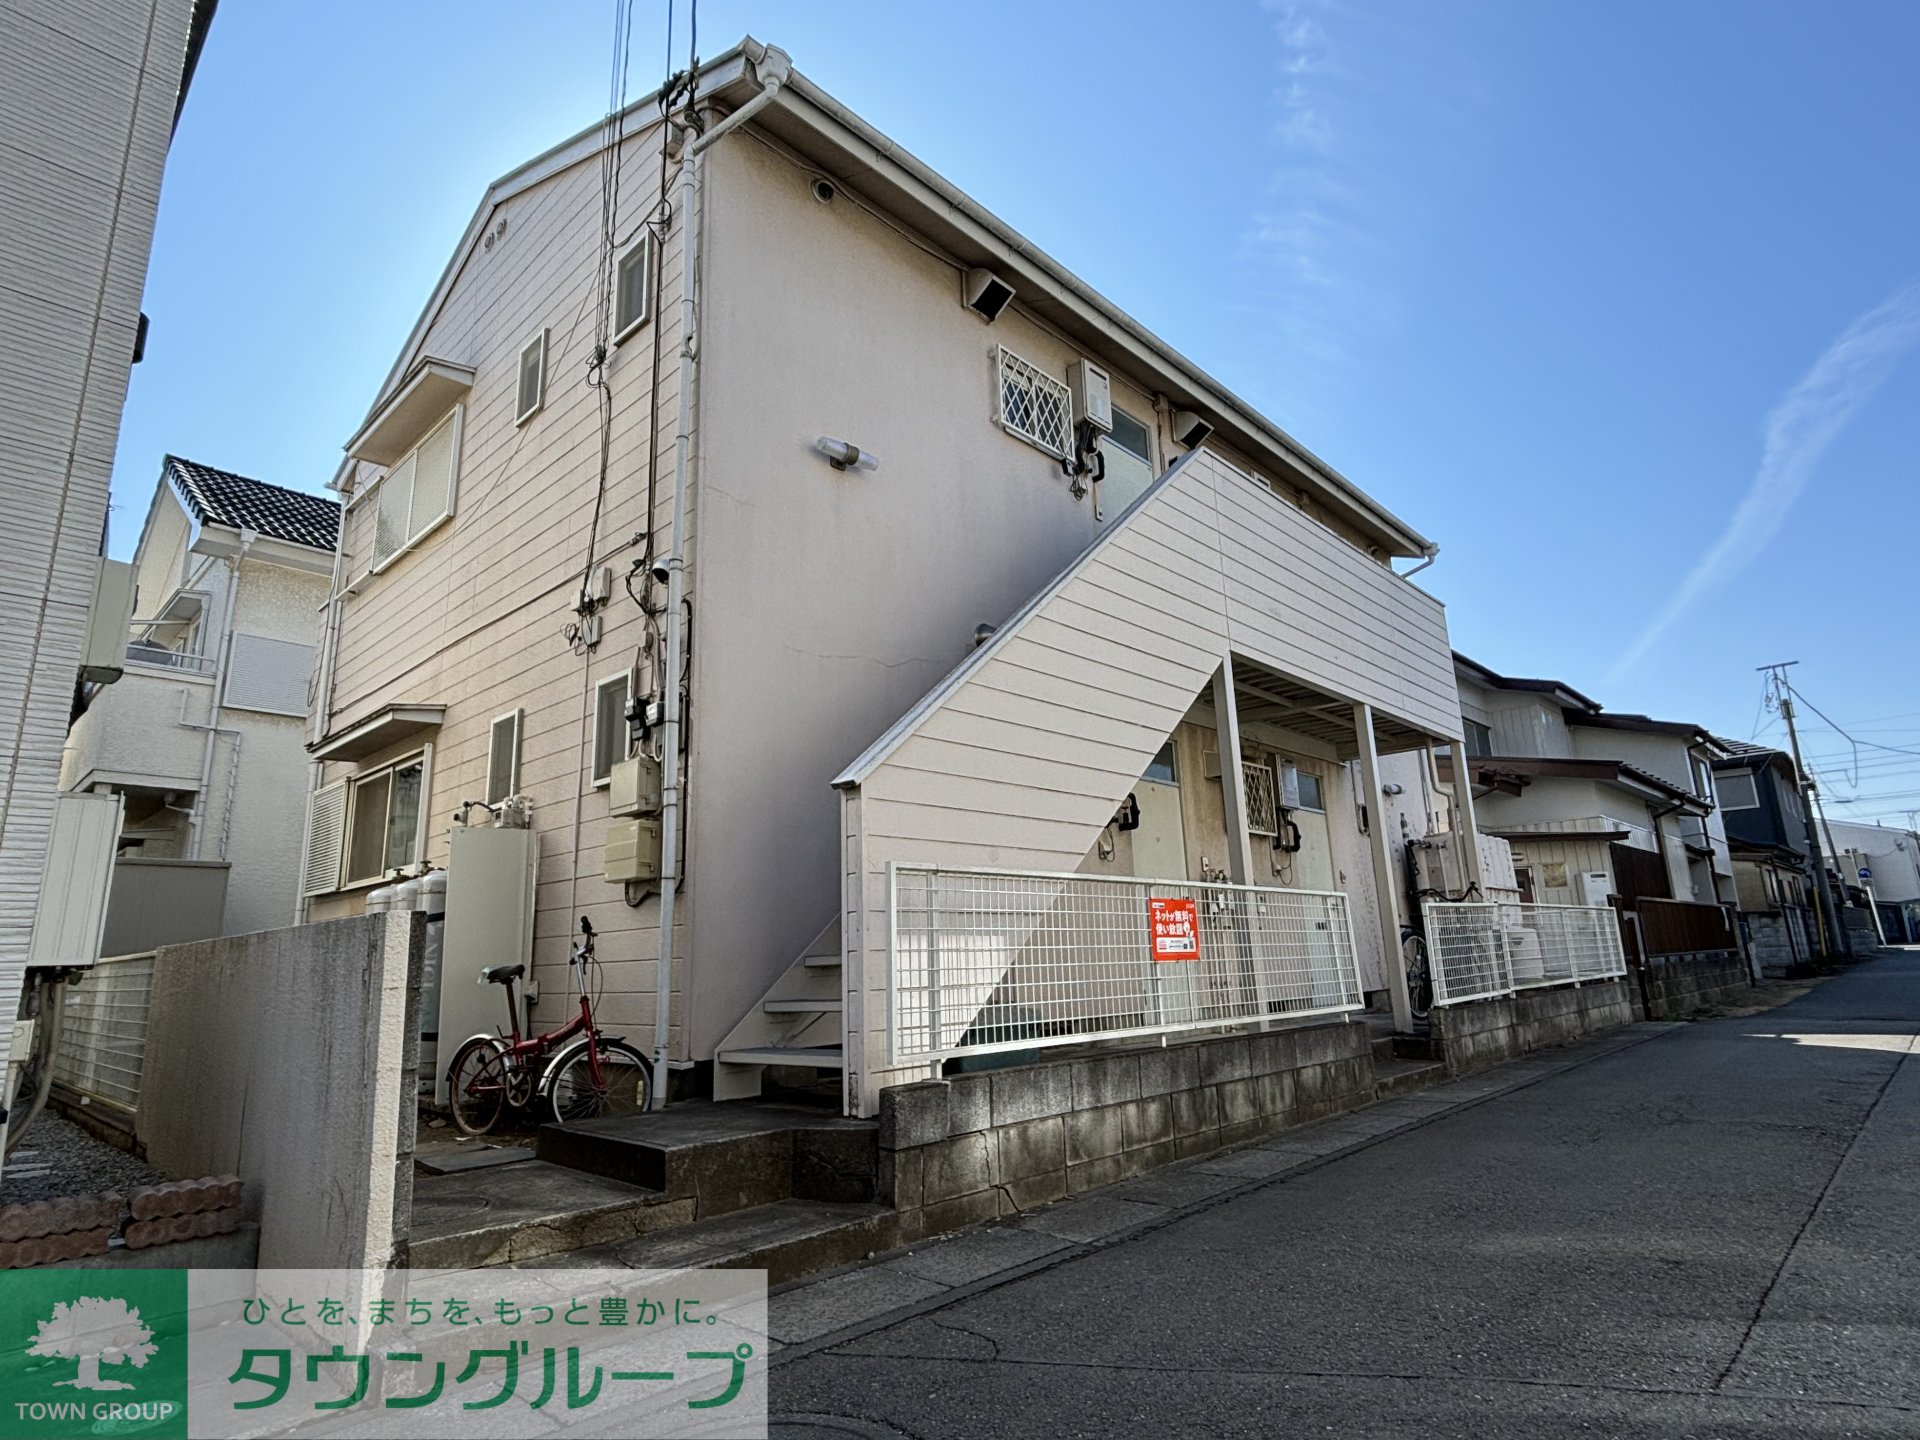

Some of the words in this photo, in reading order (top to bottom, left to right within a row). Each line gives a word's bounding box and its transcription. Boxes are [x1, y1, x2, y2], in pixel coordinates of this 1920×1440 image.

[1155, 910, 1194, 922] ネットが無料で
